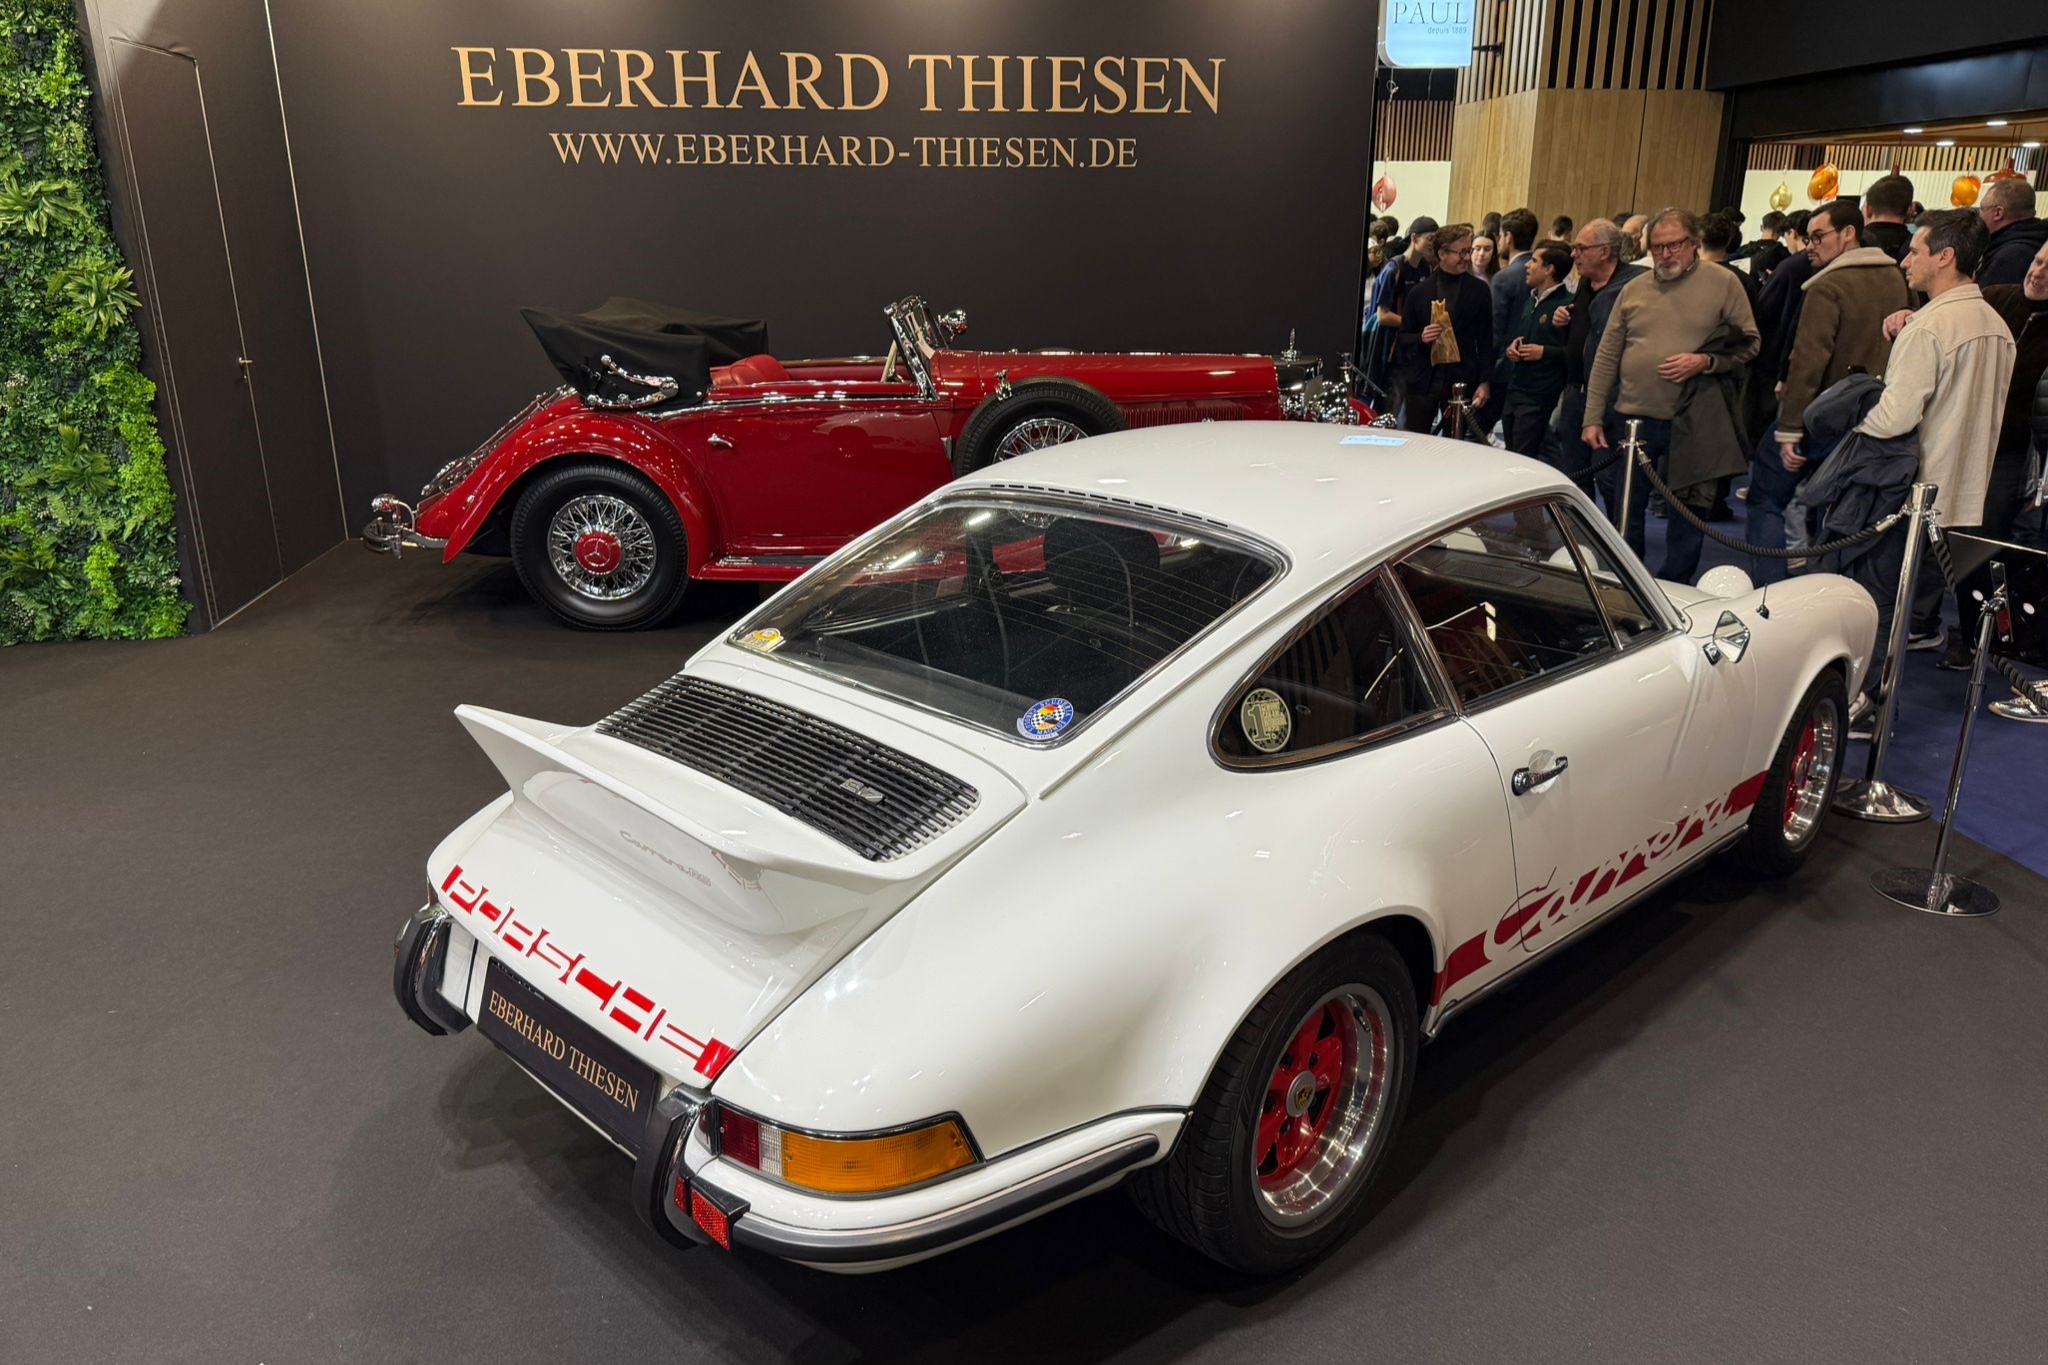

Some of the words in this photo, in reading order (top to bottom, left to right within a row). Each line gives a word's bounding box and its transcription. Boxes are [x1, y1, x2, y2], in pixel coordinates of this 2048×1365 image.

[1394, 1, 1469, 25] PAUL
[1428, 26, 1449, 34] depuis
[1452, 26, 1467, 34] 1889
[452, 46, 890, 111] EBERHARD
[908, 54, 1226, 114] THIESEN
[550, 132, 1138, 168] WWW.EBERHARD-THIESEN.DE
[1484, 790, 1737, 962] Carrera
[444, 866, 714, 1072] PORSCHE
[488, 990, 566, 1061] EBERHARD
[568, 1046, 640, 1113] THIESEN
